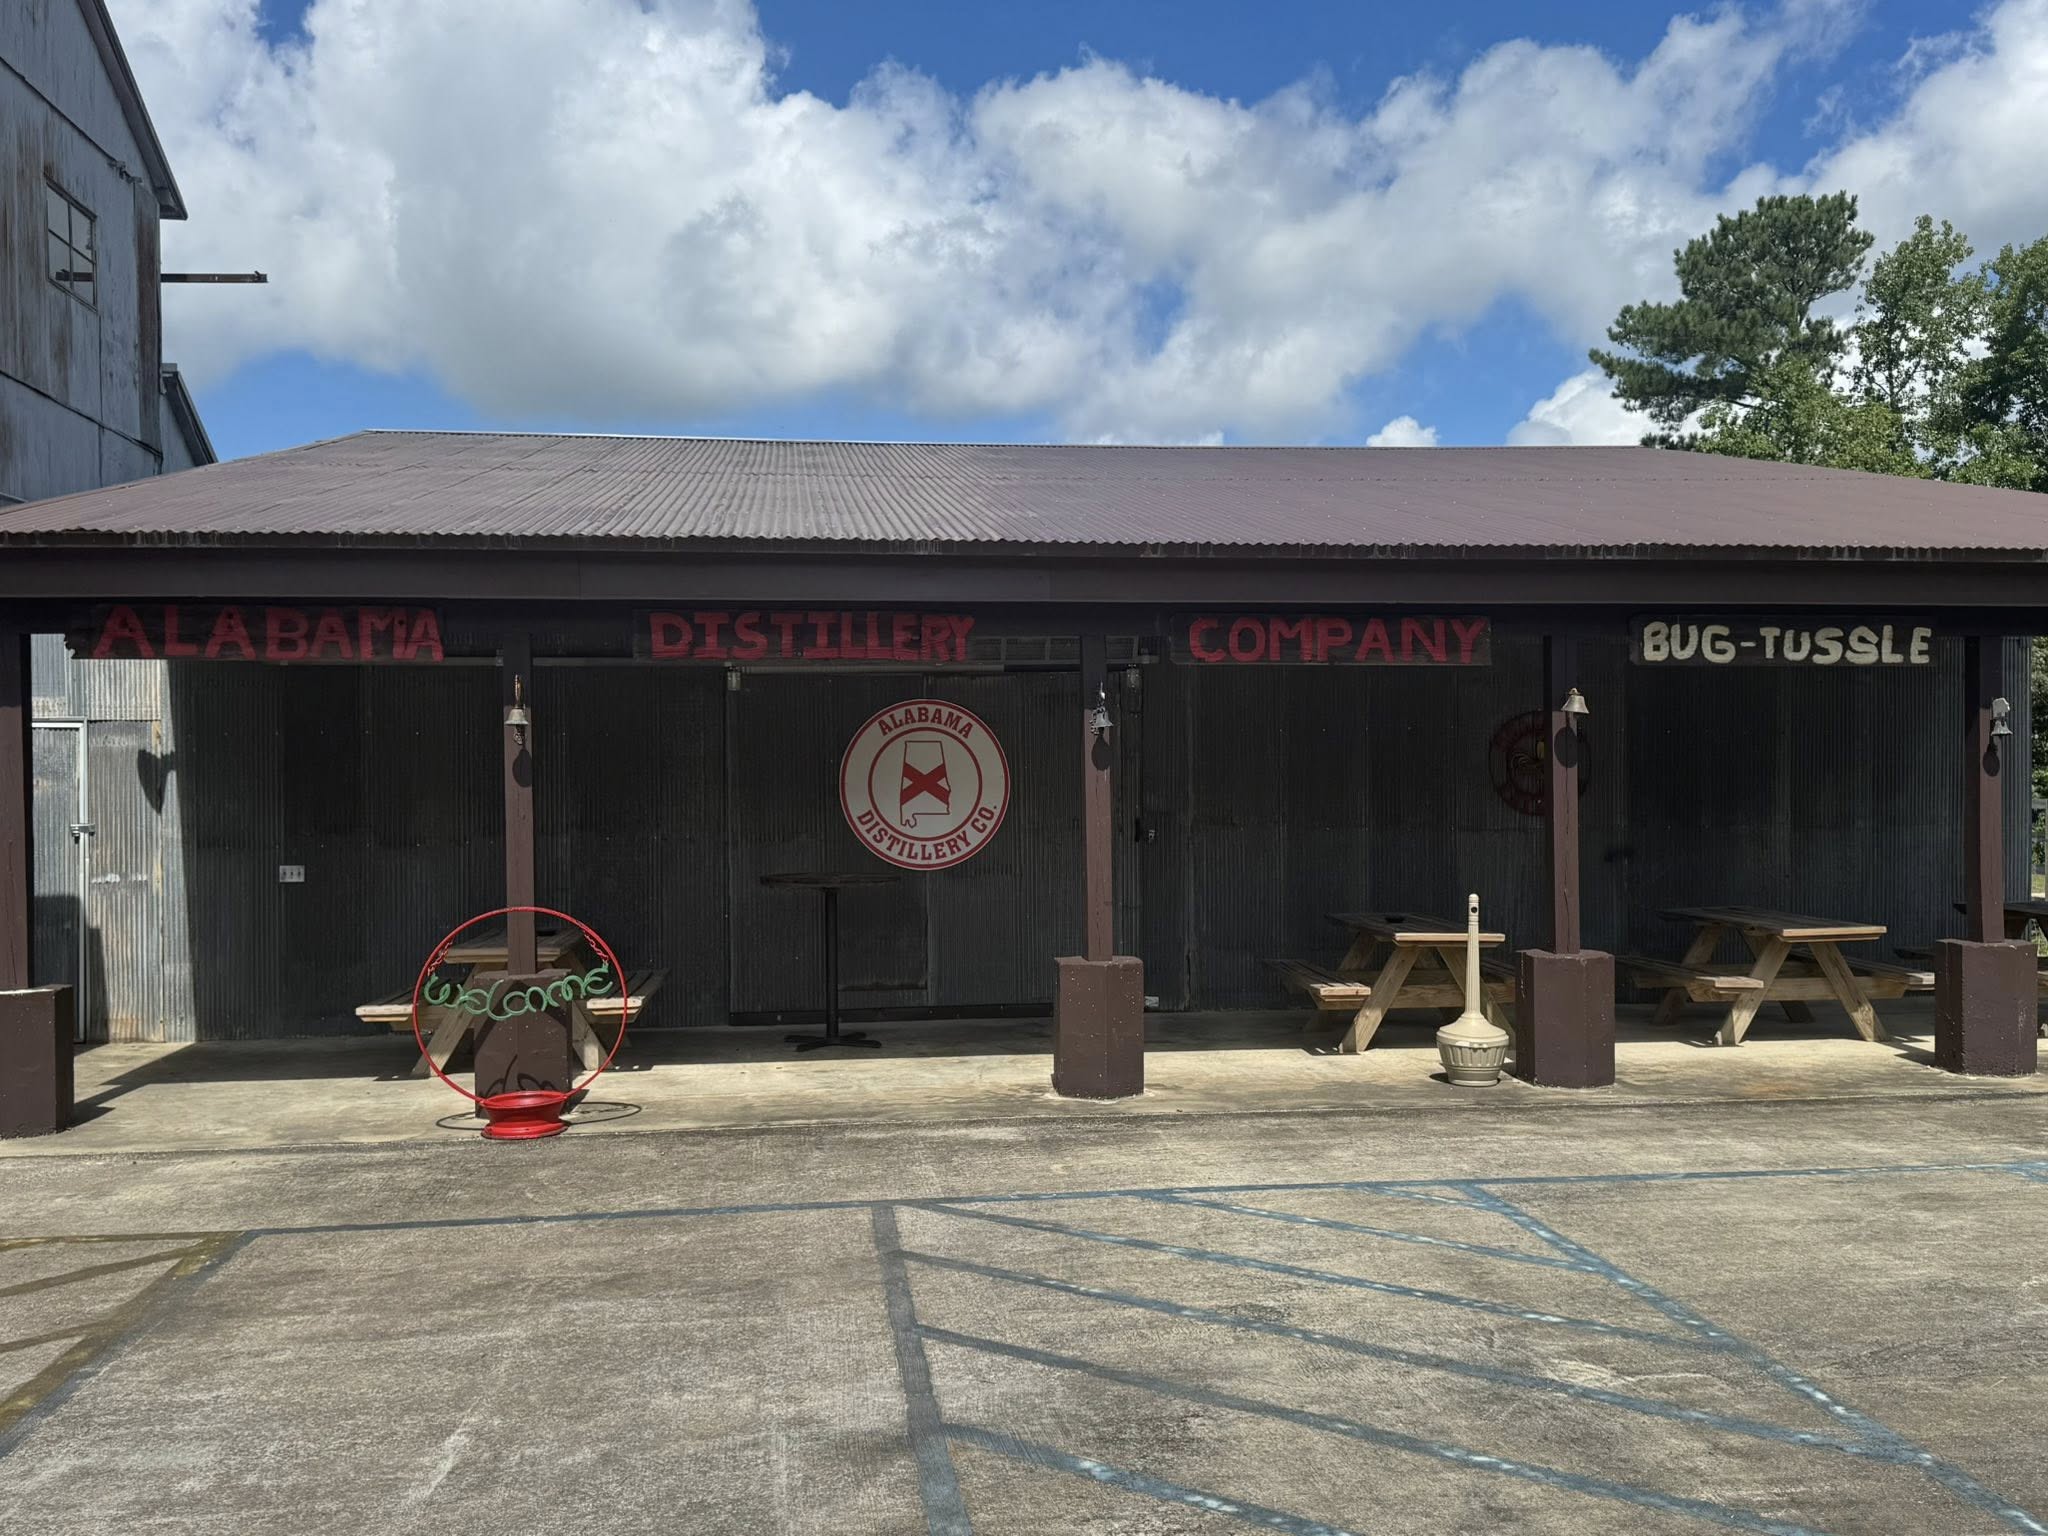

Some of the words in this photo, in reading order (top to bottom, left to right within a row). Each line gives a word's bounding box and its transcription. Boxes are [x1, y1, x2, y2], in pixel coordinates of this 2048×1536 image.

[93, 605, 444, 662] ALABAMA
[650, 611, 975, 662] DISTILLERY
[1189, 617, 1488, 664] COMPANY
[1643, 621, 1932, 664] BUG-TUSSLE
[877, 706, 975, 739] ALABAMA
[857, 809, 972, 861] DISTILLERY
[970, 804, 998, 834] CO.
